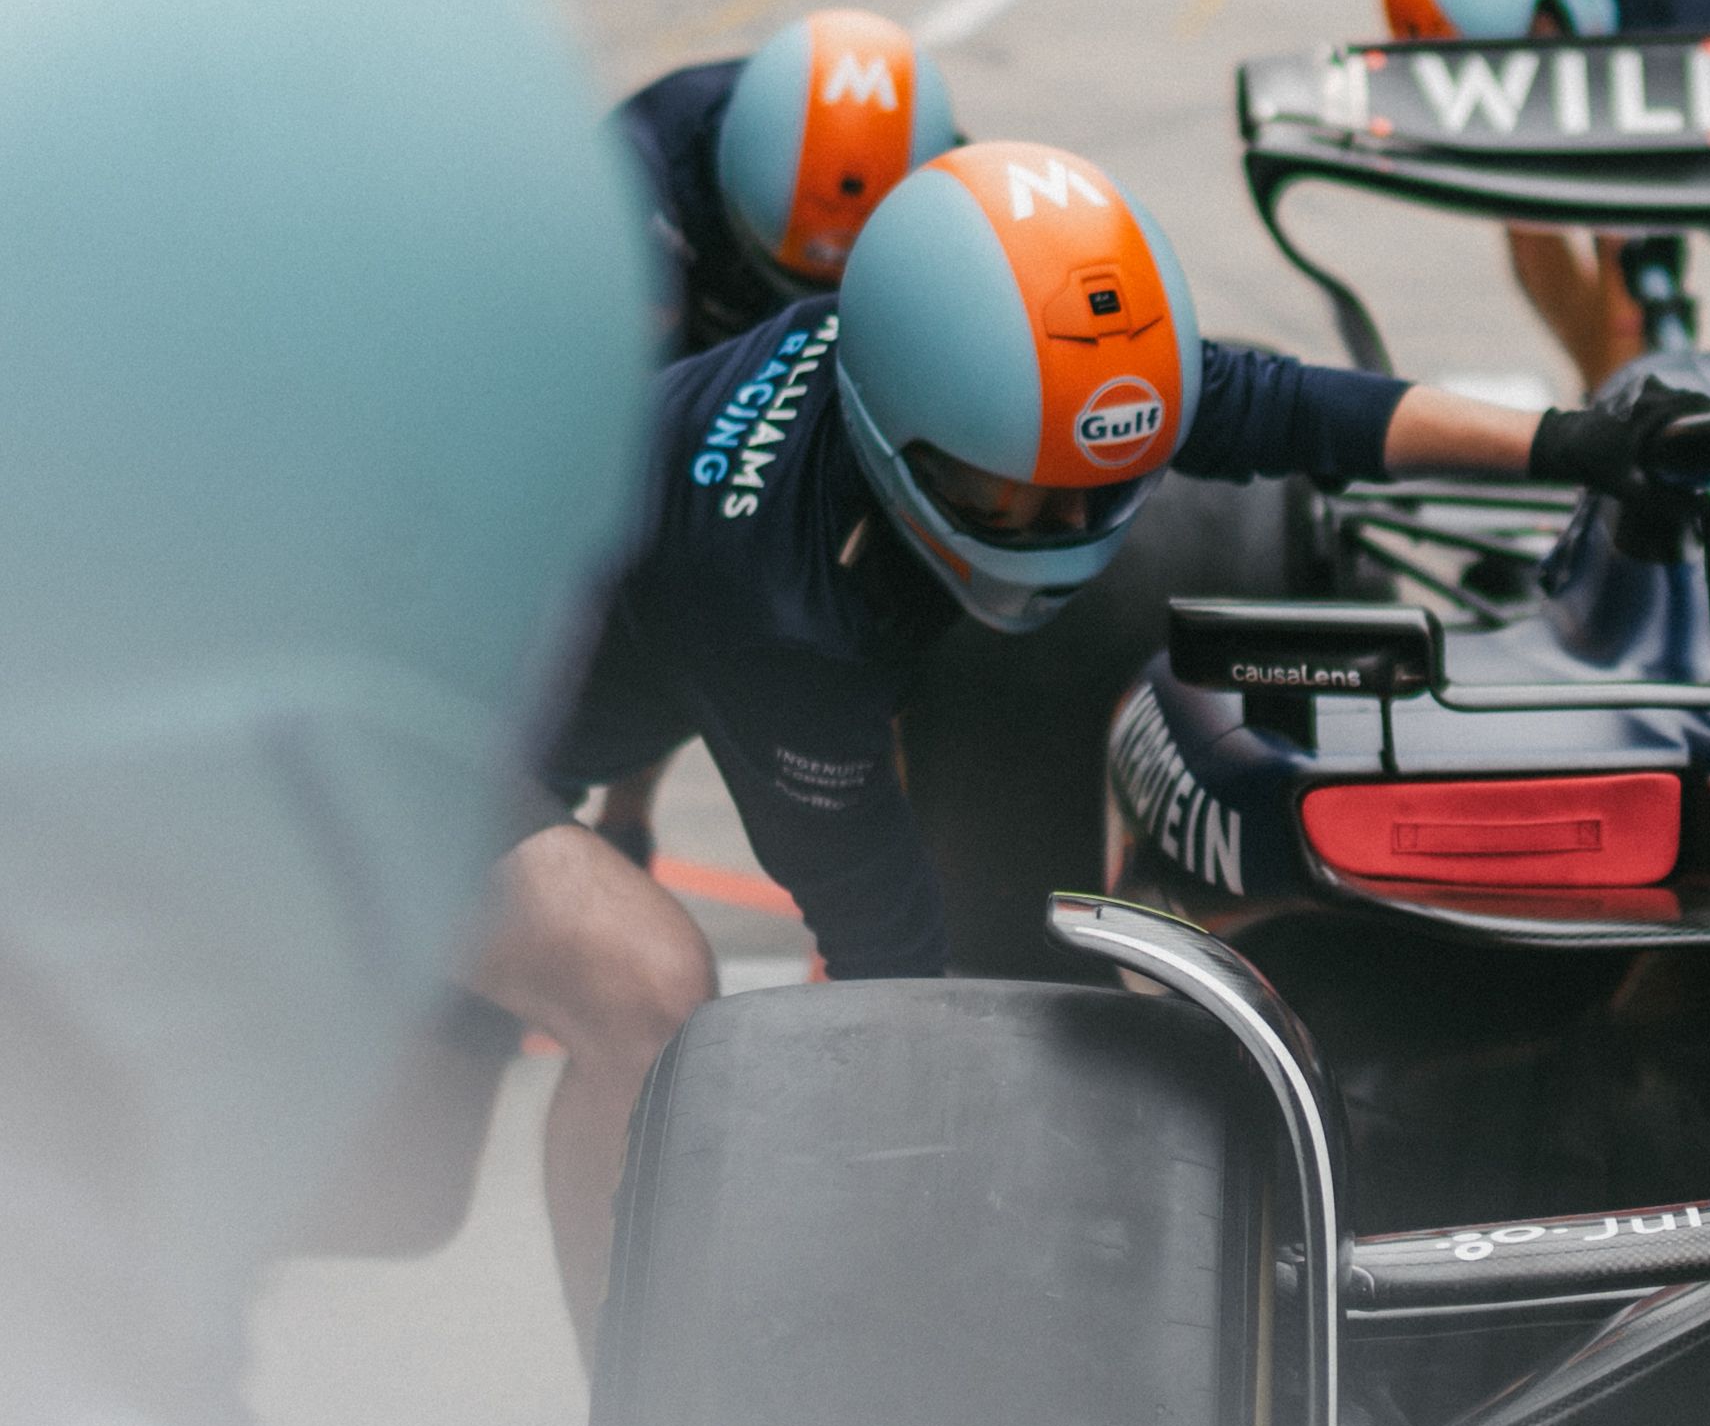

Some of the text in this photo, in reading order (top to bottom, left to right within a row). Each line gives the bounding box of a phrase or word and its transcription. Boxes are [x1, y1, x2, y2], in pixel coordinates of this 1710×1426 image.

[693, 330, 809, 487] RACING
[1080, 405, 1160, 441] Gulf
[1231, 663, 1362, 687] causaLens
